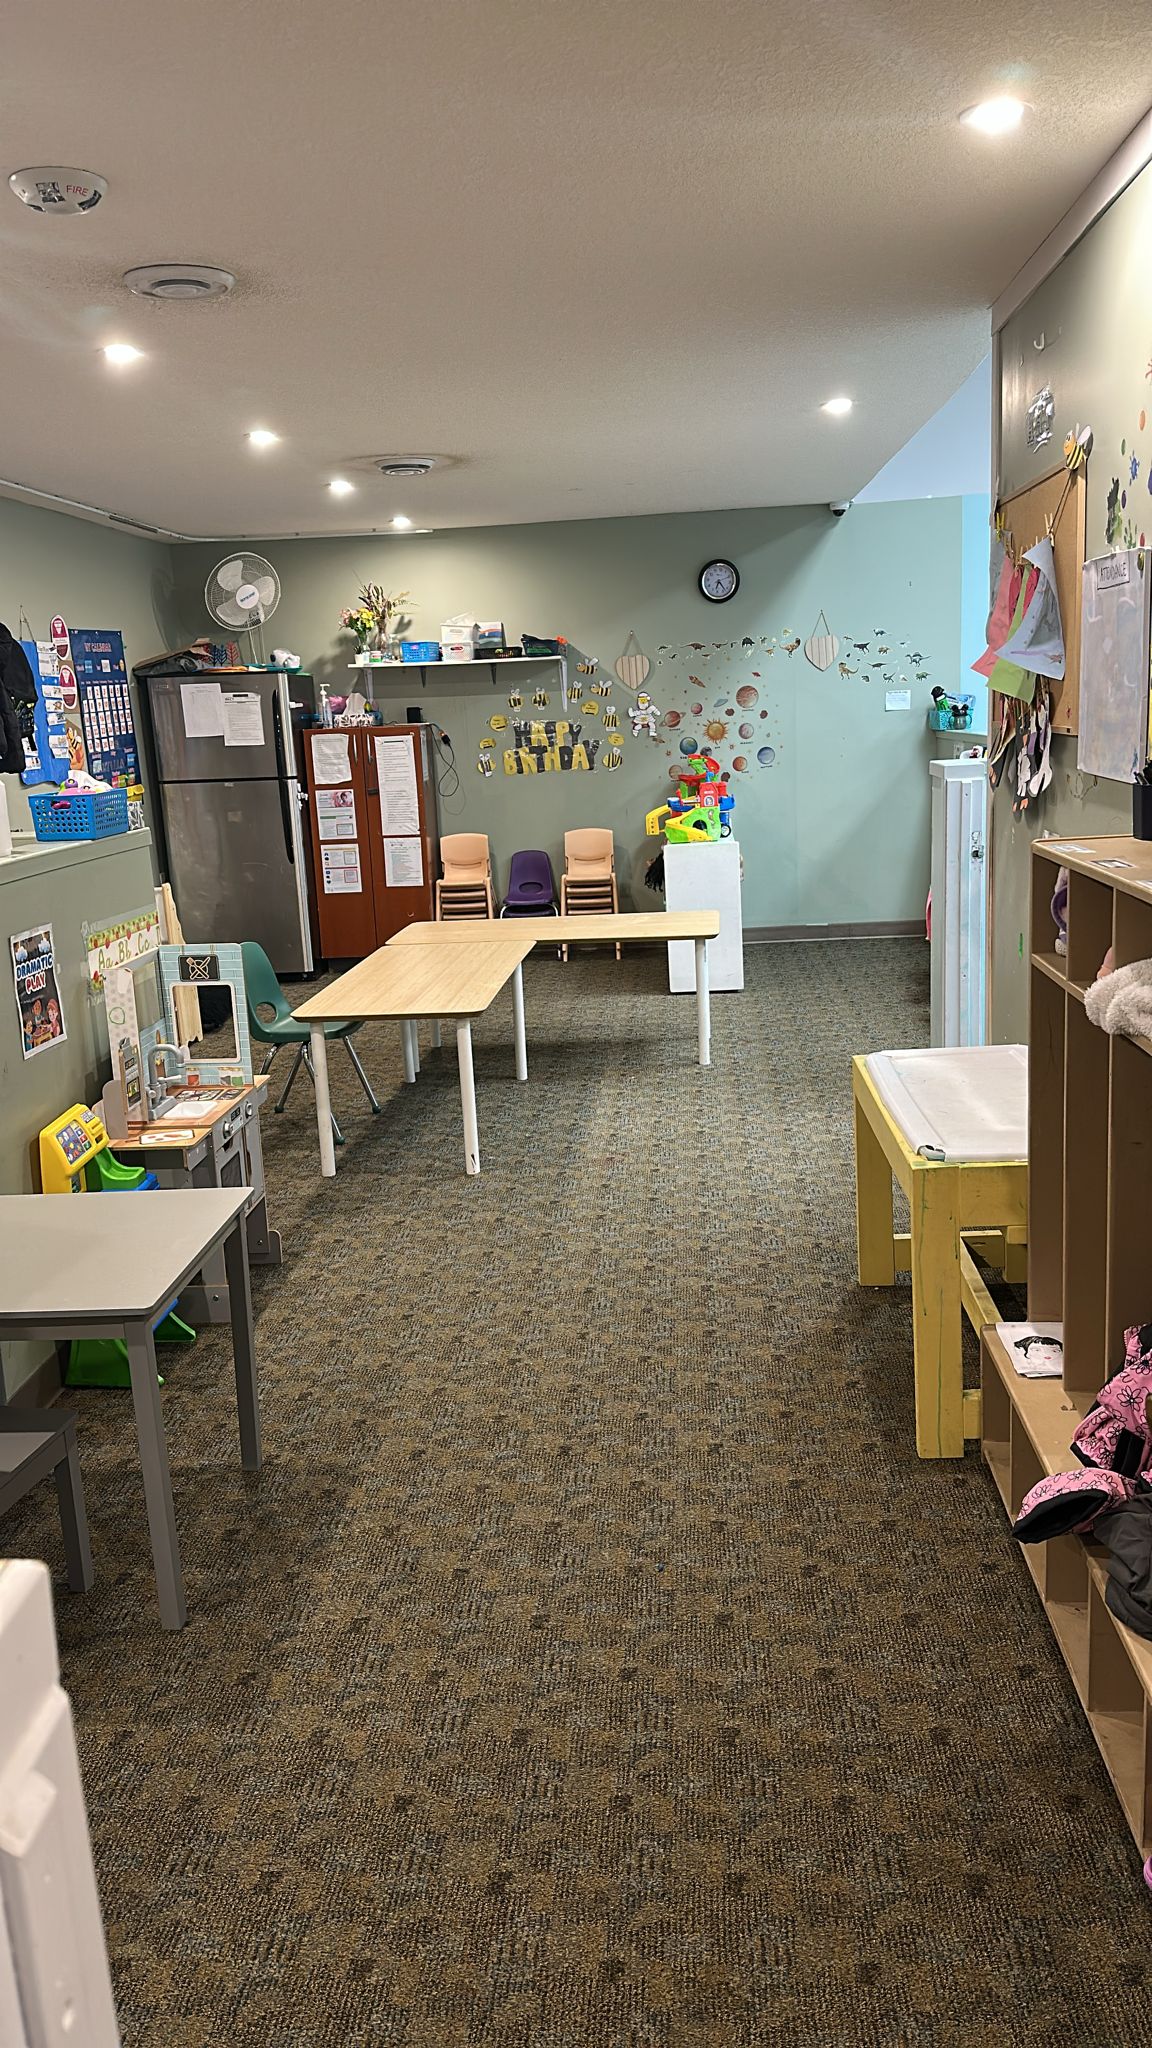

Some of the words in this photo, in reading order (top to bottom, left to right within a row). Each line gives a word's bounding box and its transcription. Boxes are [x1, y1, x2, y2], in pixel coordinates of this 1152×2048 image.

[66, 184, 89, 197] FIRE
[513, 719, 582, 748] HAPPY
[503, 740, 600, 776] BIRTHDAY
[16, 953, 53, 980] DRAMATIC
[98, 948, 114, 970] Aa
[26, 972, 46, 993] PLAY
